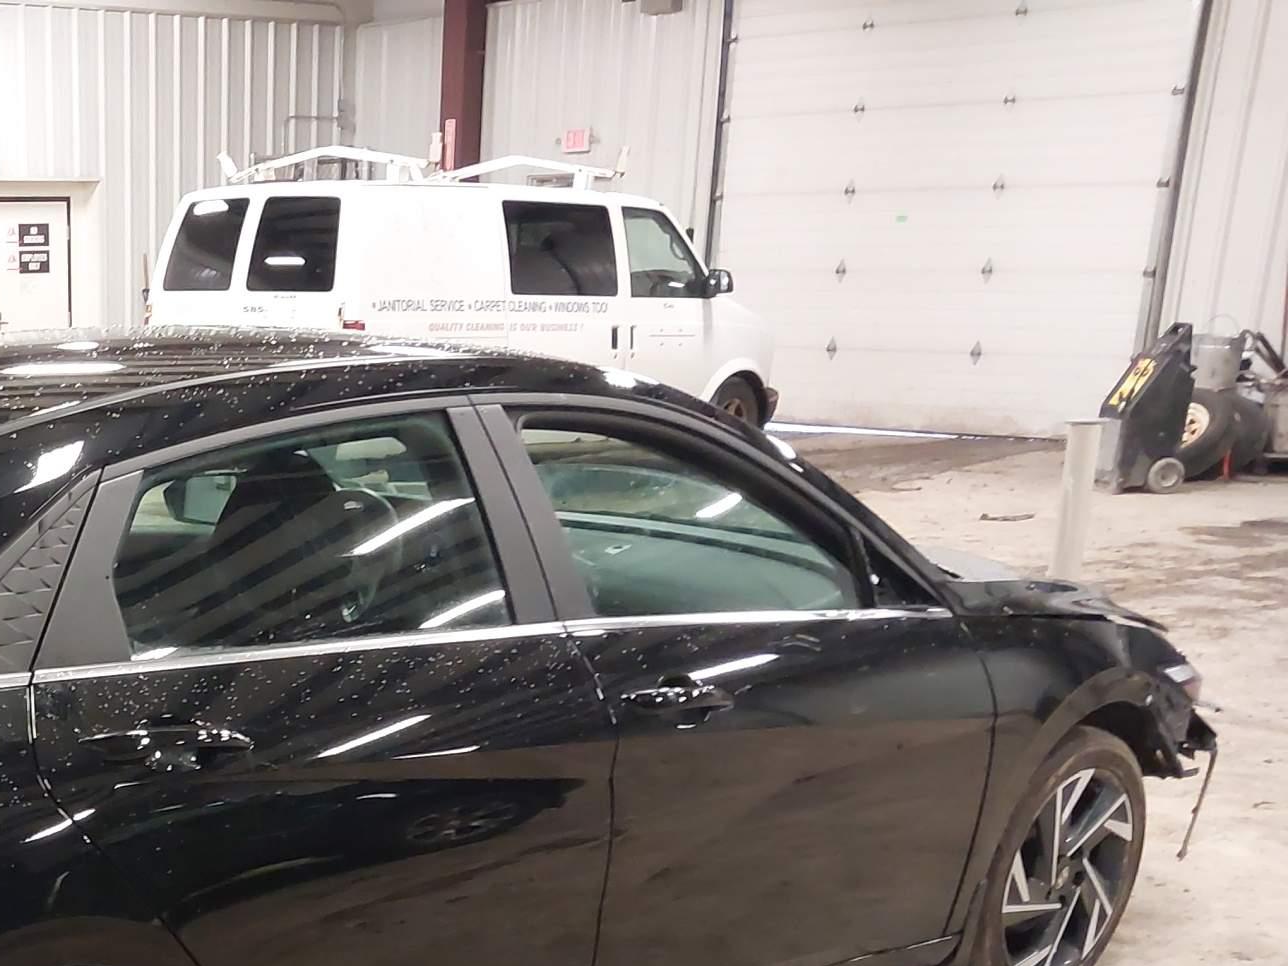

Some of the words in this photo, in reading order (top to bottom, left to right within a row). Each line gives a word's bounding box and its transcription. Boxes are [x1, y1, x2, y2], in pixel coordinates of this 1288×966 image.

[377, 299, 427, 312] JANITORIAL
[430, 299, 465, 312] SERVICE
[474, 299, 506, 312] CARPET
[509, 300, 547, 312] CLEANING
[554, 301, 589, 313] WINDOWS
